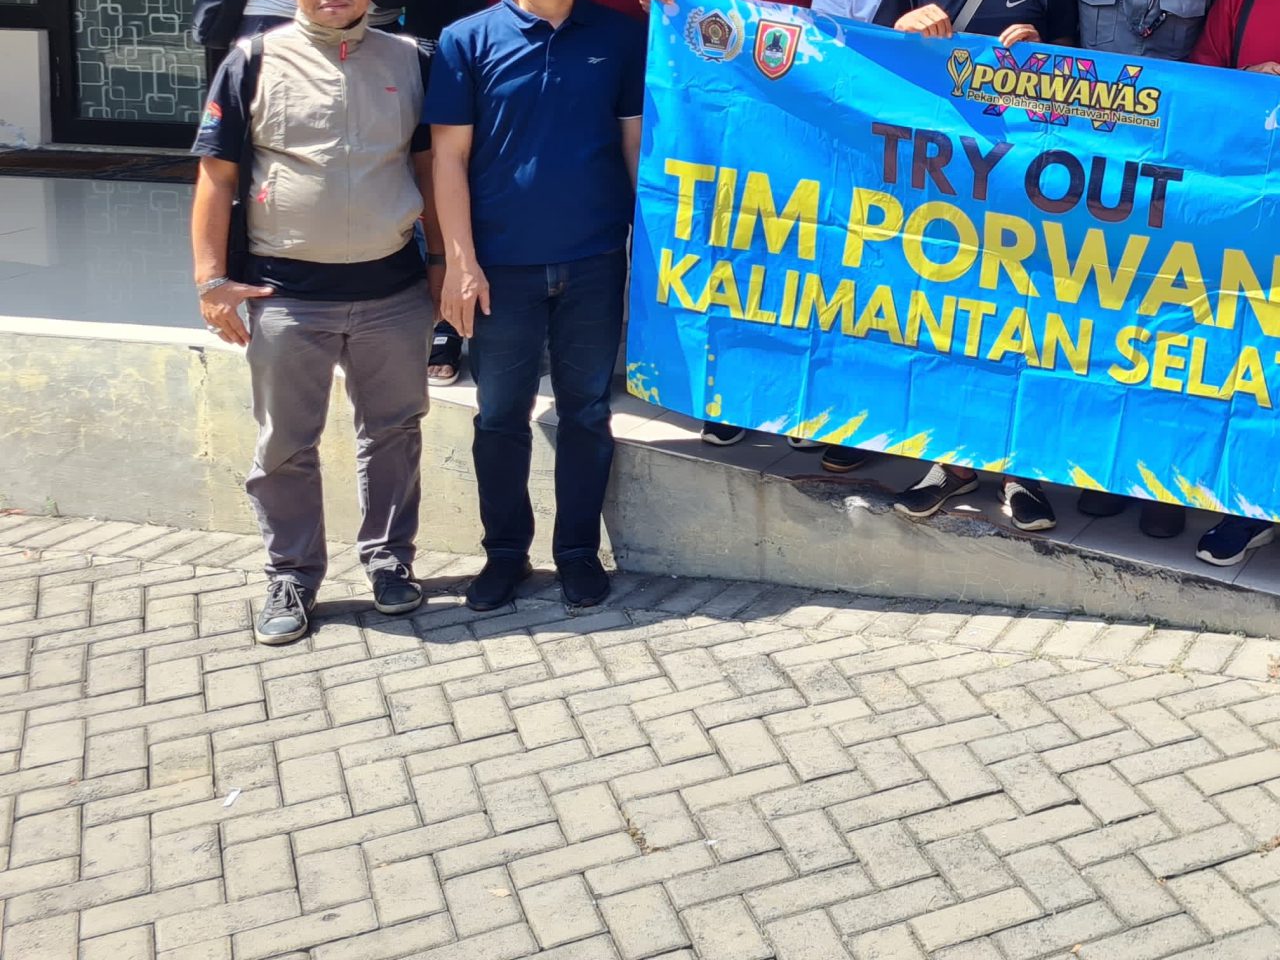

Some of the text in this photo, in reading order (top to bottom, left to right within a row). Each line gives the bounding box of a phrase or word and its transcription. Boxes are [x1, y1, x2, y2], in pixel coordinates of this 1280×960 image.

[967, 89, 1160, 129] Pekan Olahraga Wartawan Nasional
[970, 62, 1162, 116] PORWANAS
[664, 157, 821, 261] TIM
[872, 121, 1184, 228] TRY OUT
[656, 248, 1094, 376] KALIMANTAN
